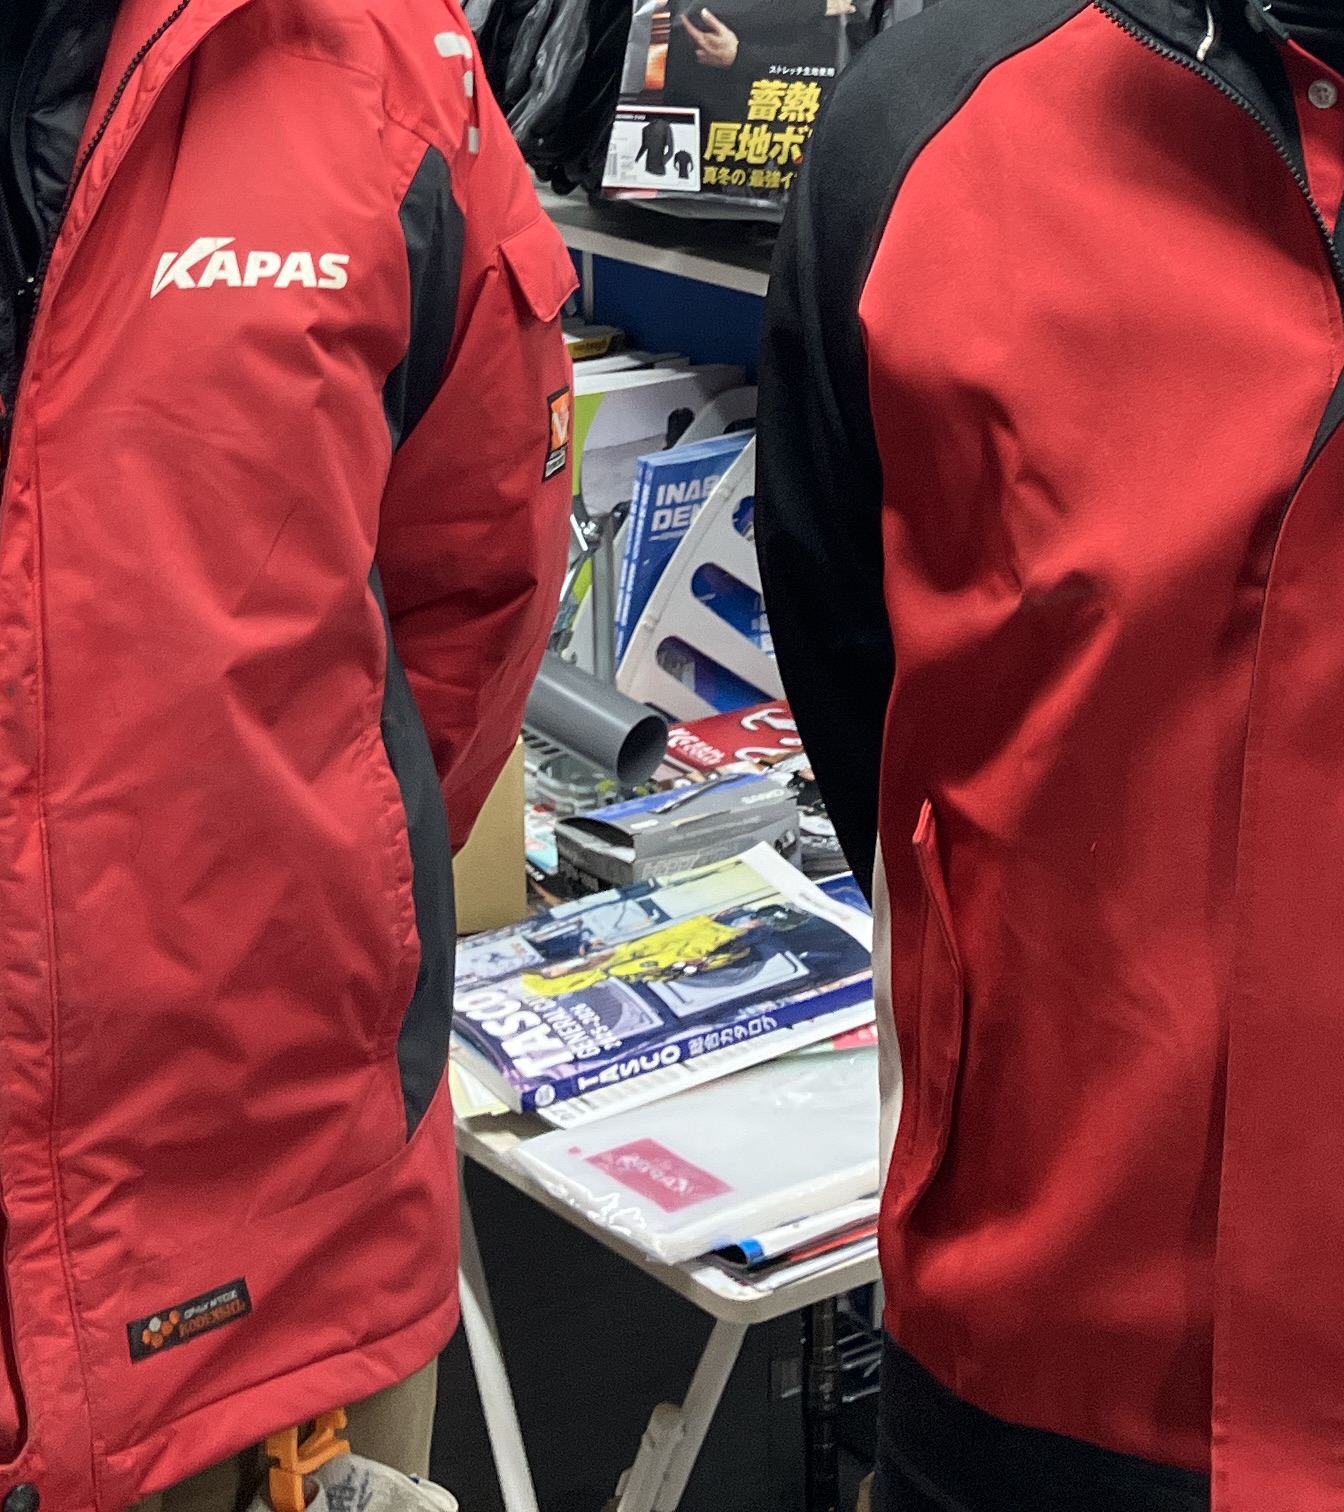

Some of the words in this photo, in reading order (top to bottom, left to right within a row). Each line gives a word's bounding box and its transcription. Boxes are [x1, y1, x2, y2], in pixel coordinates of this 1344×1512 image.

[747, 78, 822, 123] 蓄熱
[150, 237, 350, 299] KAPAS
[453, 989, 575, 1078] TASCO
[543, 1006, 601, 1059] GENERAL
[578, 1044, 681, 1092] TASCO
